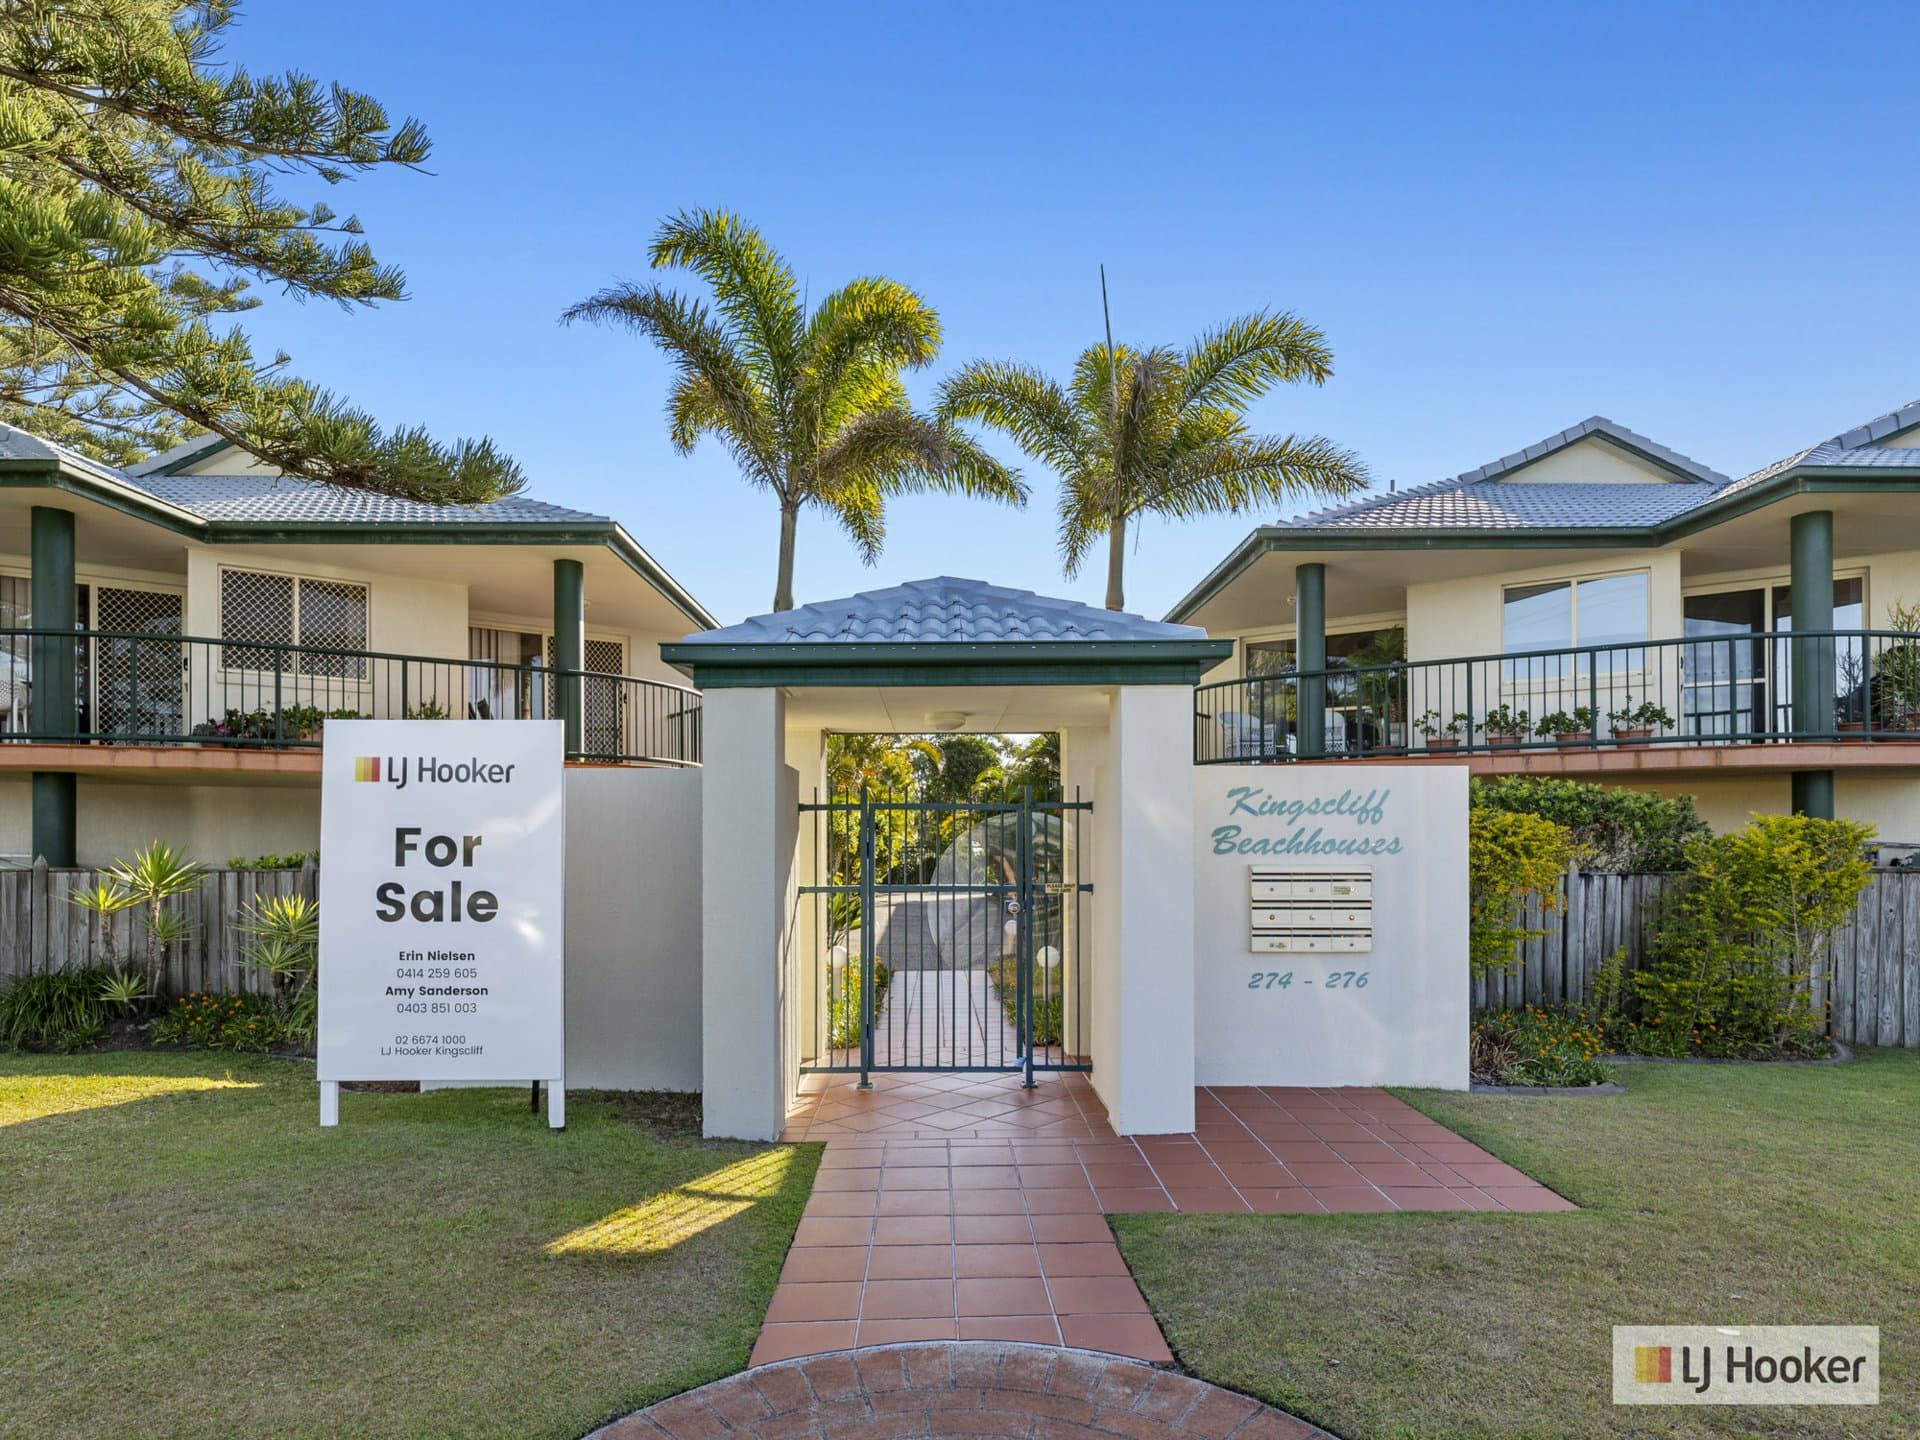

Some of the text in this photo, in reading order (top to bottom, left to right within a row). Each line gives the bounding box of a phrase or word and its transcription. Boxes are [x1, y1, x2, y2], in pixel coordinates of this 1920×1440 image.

[387, 757, 515, 790] LJ Hooker
[1226, 786, 1391, 826] Kingscliff
[394, 827, 482, 868] For
[1210, 825, 1404, 856] Beachhouses
[375, 880, 499, 924] Sale
[399, 950, 475, 961] Erin Nielsen
[396, 967, 478, 979] 0414 259 605
[1247, 971, 1293, 989] 274
[1325, 971, 1370, 989] 276
[385, 986, 488, 998] Amy Sanderson
[396, 1002, 477, 1014] 0403 851 003
[395, 1035, 466, 1045] 02 6674 1000
[381, 1046, 483, 1058] LJ Hooker Kingscliff
